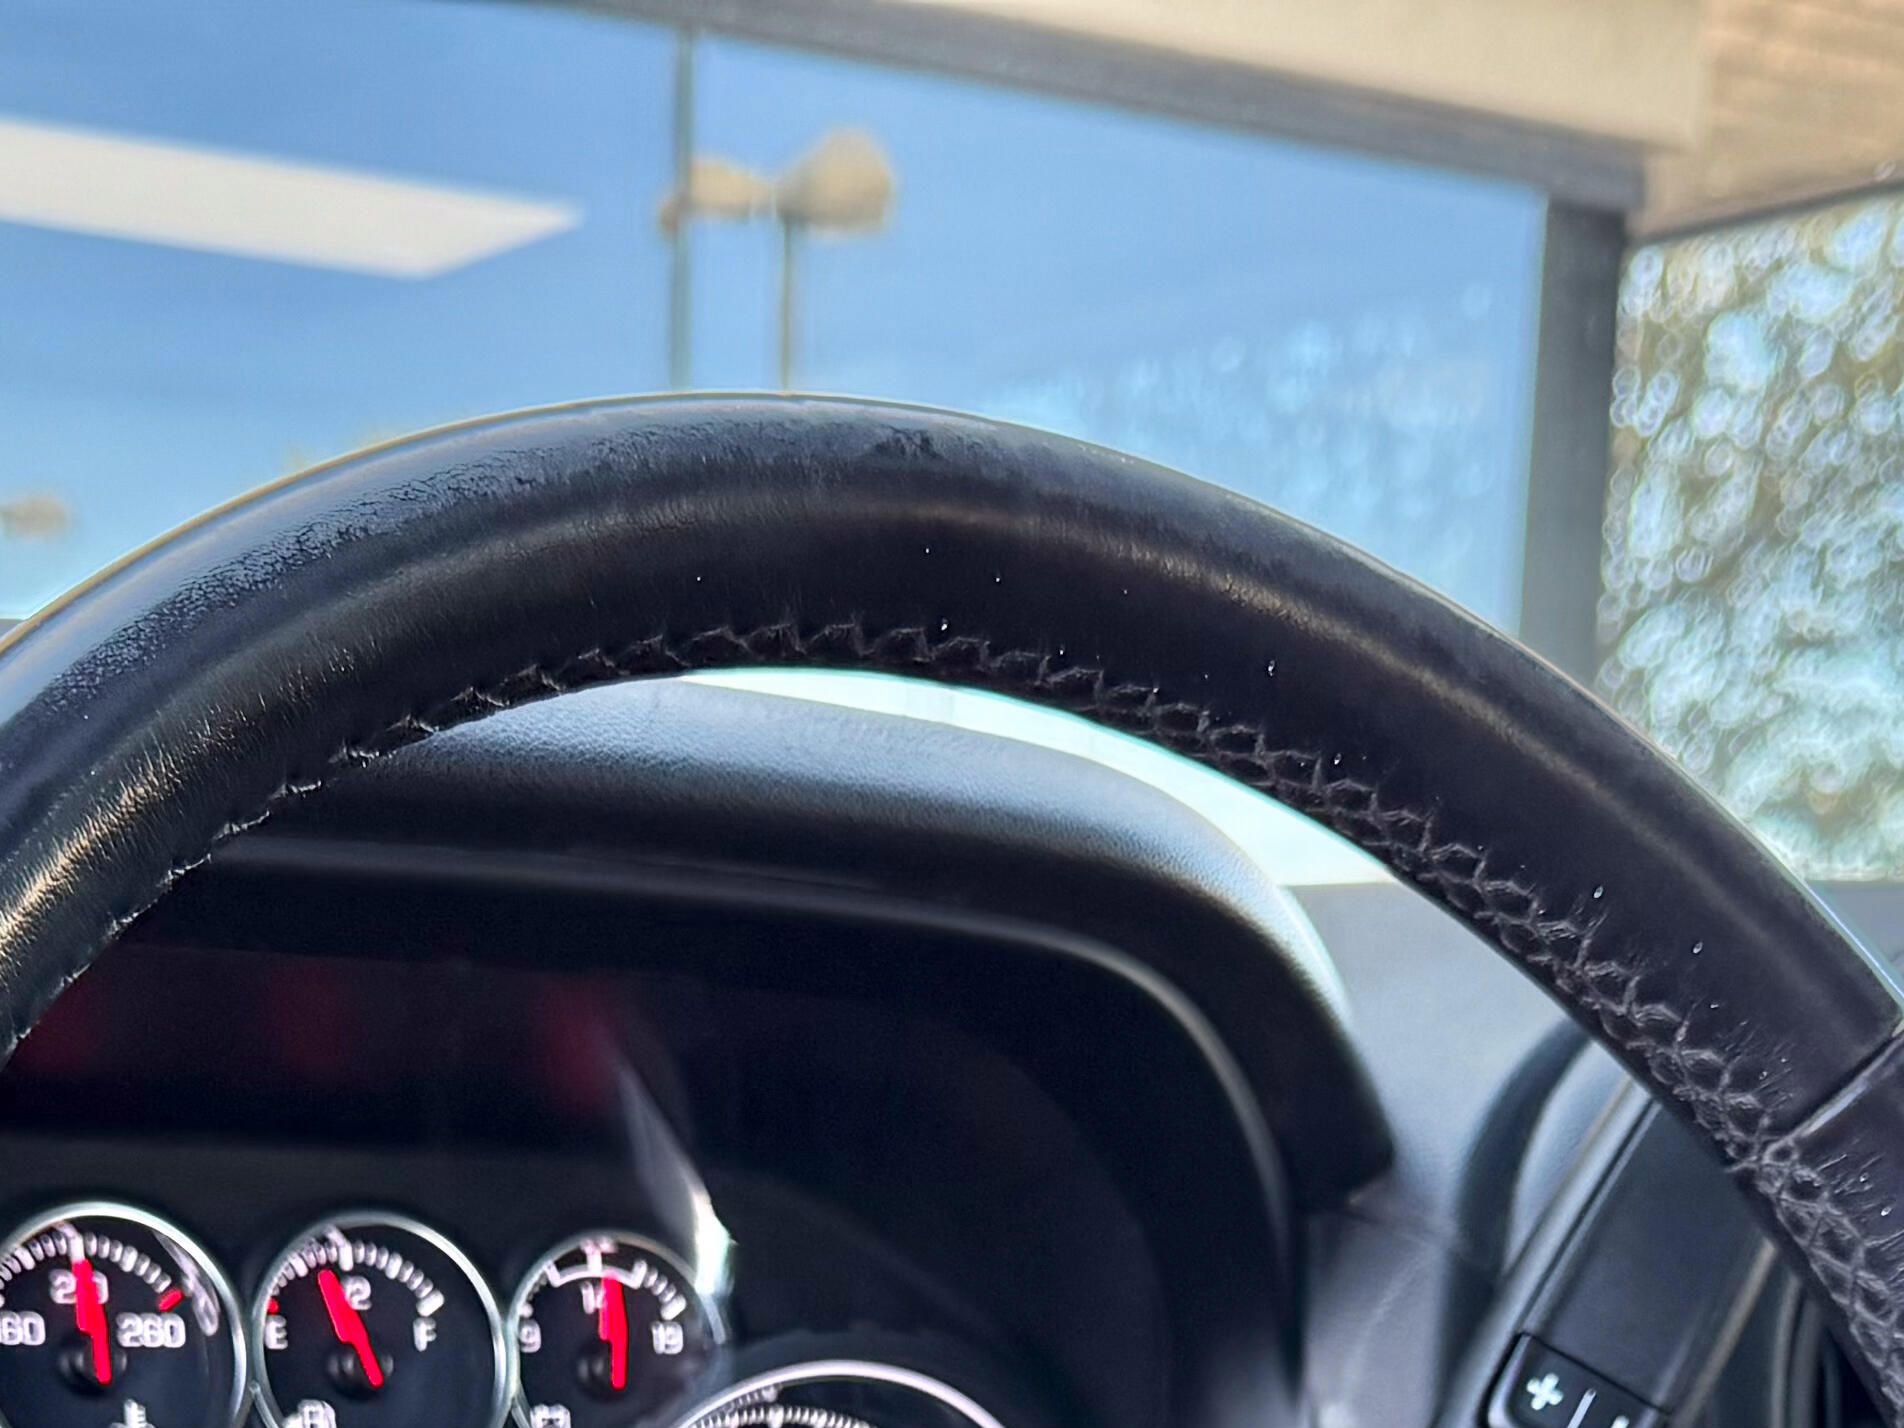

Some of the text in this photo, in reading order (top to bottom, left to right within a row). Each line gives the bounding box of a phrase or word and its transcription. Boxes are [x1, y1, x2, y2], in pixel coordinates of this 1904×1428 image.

[49, 1268, 109, 1305] 20
[116, 1312, 186, 1348] 260
[265, 1314, 289, 1350] E
[412, 1316, 437, 1352] F
